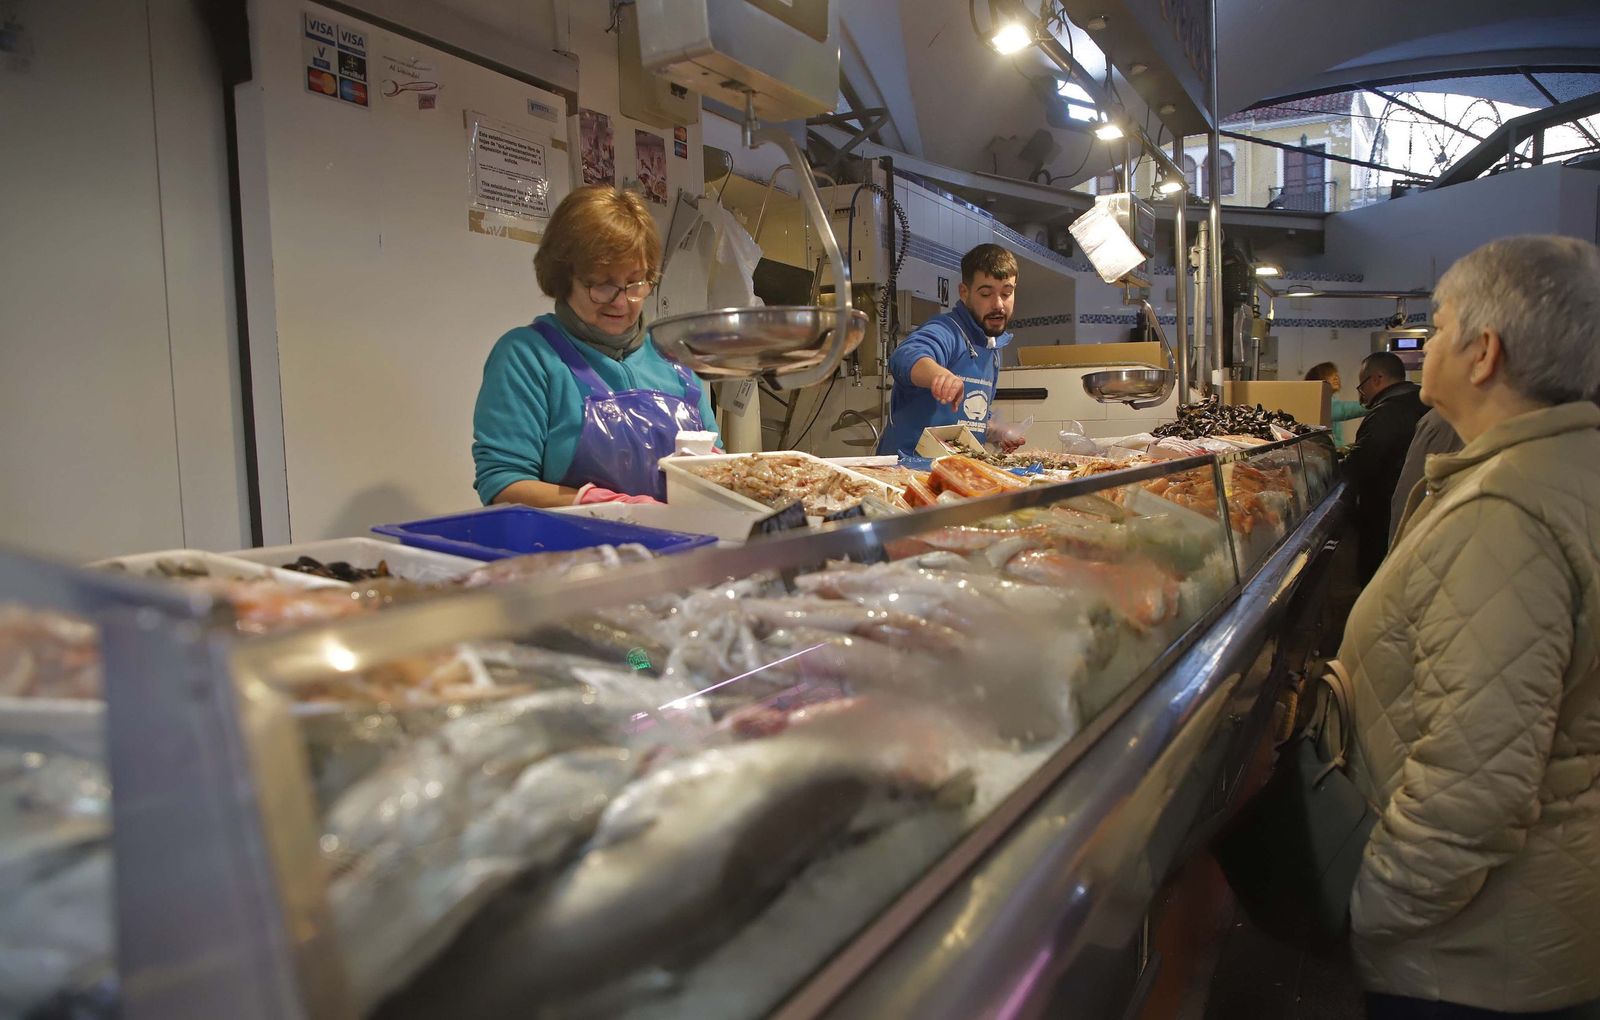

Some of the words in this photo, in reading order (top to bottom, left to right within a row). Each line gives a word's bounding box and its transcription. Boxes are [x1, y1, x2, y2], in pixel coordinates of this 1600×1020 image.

[309, 20, 334, 37] VISA
[341, 31, 365, 47] VISA
[490, 183, 517, 193] establishment
